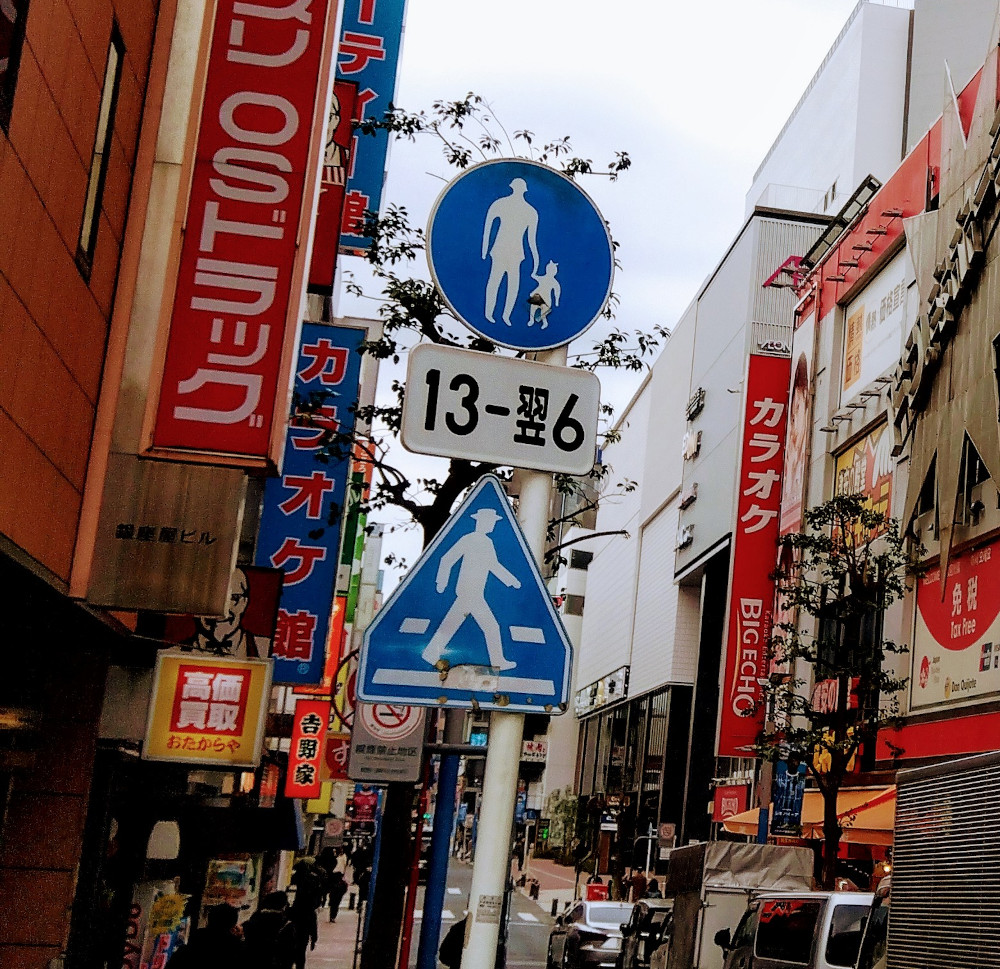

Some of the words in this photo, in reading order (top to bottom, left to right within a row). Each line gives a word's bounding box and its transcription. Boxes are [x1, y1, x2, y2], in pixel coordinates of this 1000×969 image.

[424, 368, 585, 453] 13-翌6
[740, 397, 785, 534] カラオケ
[952, 574, 979, 618] 免税
[740, 597, 764, 648] BIG
[950, 620, 962, 640] Tax
[962, 617, 977, 636] Free
[182, 671, 245, 703] 高価
[731, 651, 757, 719] ECHO
[177, 700, 241, 731] 買取
[166, 735, 242, 754] おたからや
[294, 713, 325, 786] 吉野家
